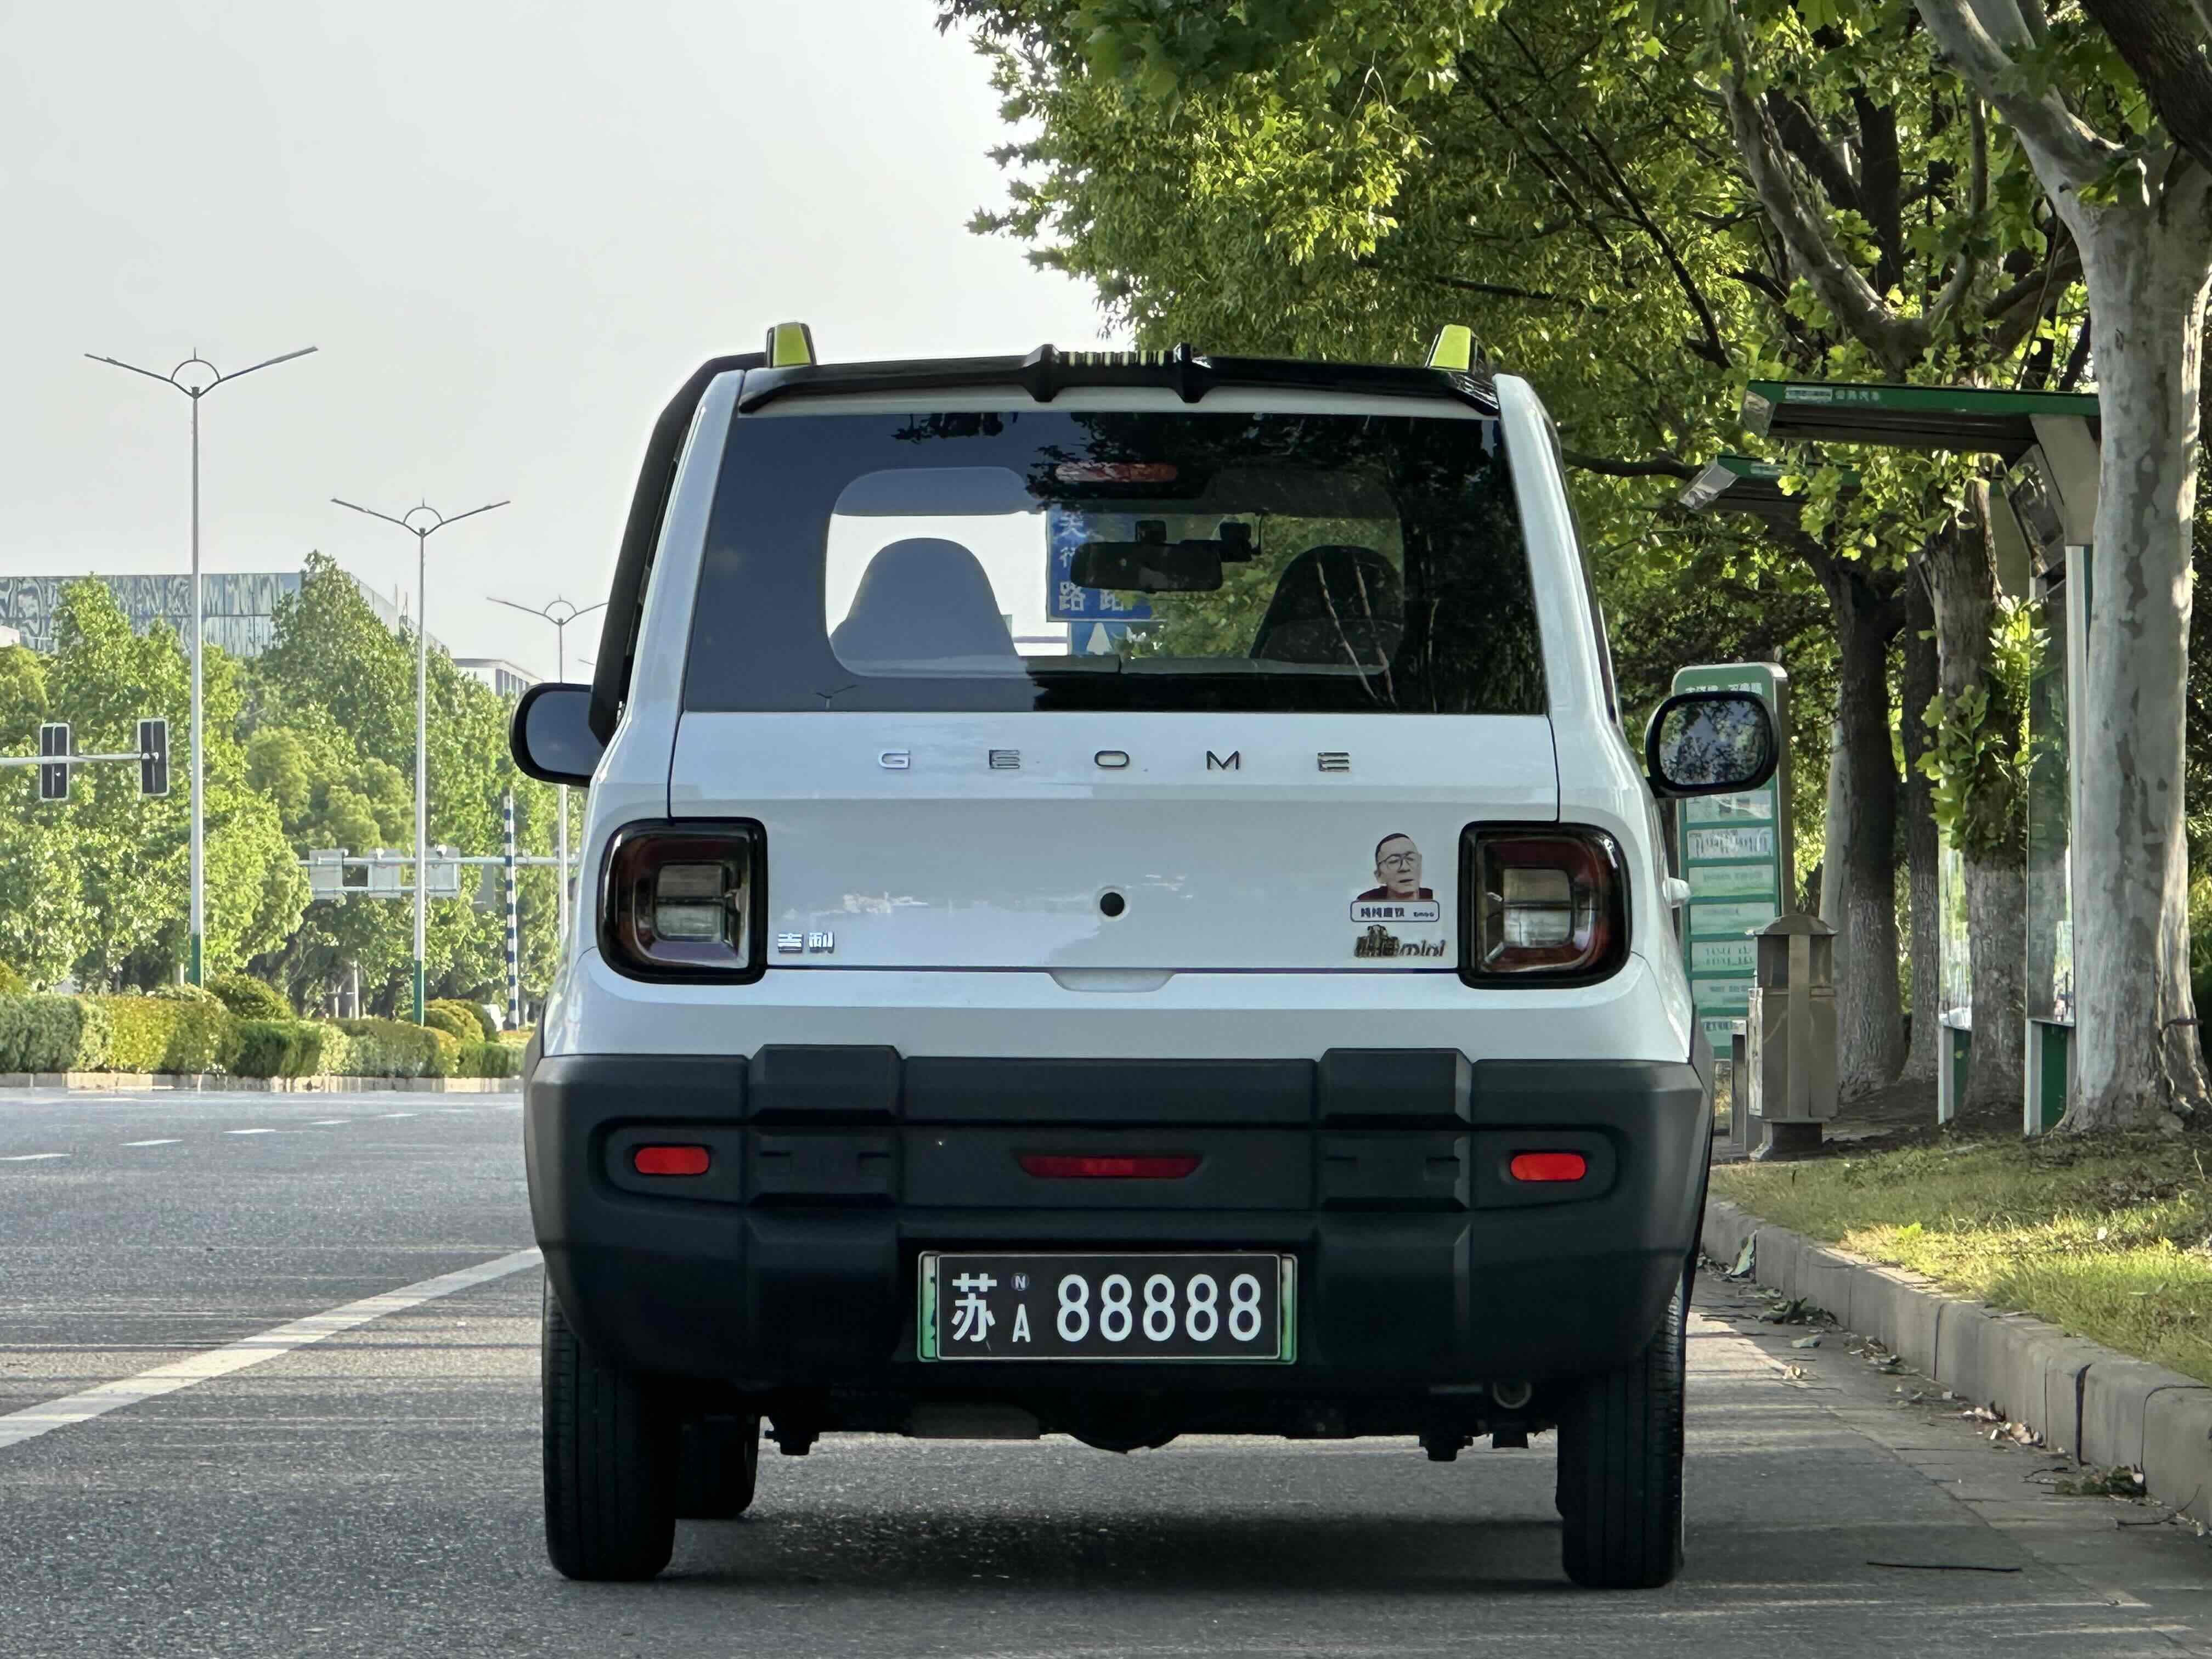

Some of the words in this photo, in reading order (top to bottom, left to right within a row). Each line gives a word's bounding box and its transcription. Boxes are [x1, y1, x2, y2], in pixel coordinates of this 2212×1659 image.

[878, 749, 1350, 772] GEOME
[777, 932, 835, 953] 吉利
[1057, 1274, 1262, 1342] 88888
